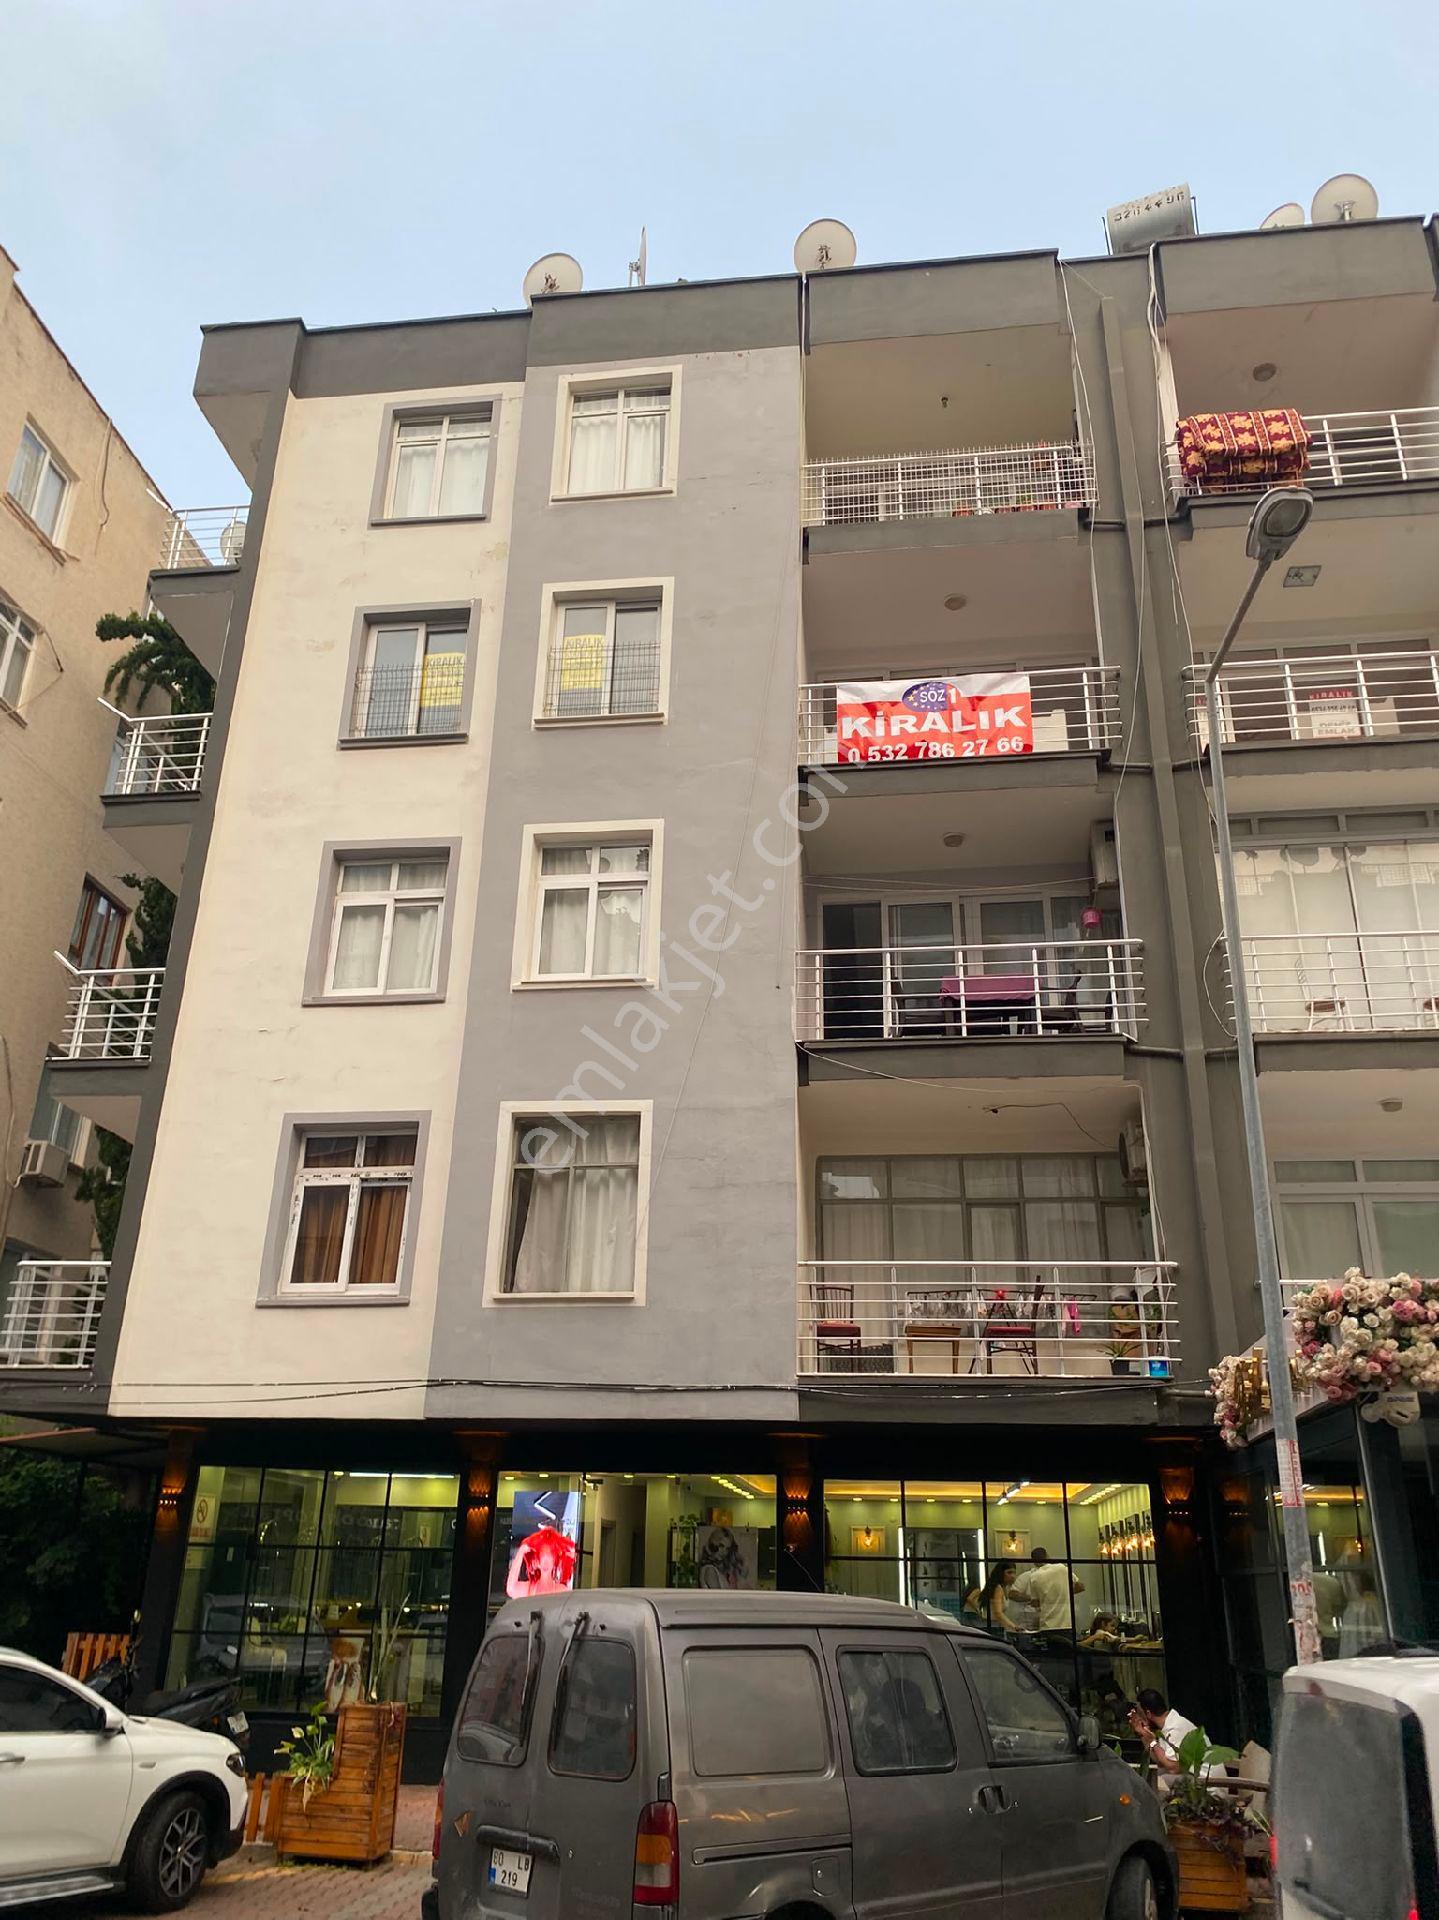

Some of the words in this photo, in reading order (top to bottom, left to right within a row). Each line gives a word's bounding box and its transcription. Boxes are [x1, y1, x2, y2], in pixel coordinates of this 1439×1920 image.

[920, 687, 945, 703] SÖZ
[842, 705, 1027, 740] KİRALIK
[848, 748, 860, 763] 0
[868, 743, 909, 761] 532
[914, 740, 955, 759] 786
[962, 738, 988, 757] 27
[996, 736, 1025, 752] 66
[501, 1869, 518, 1887] 219
